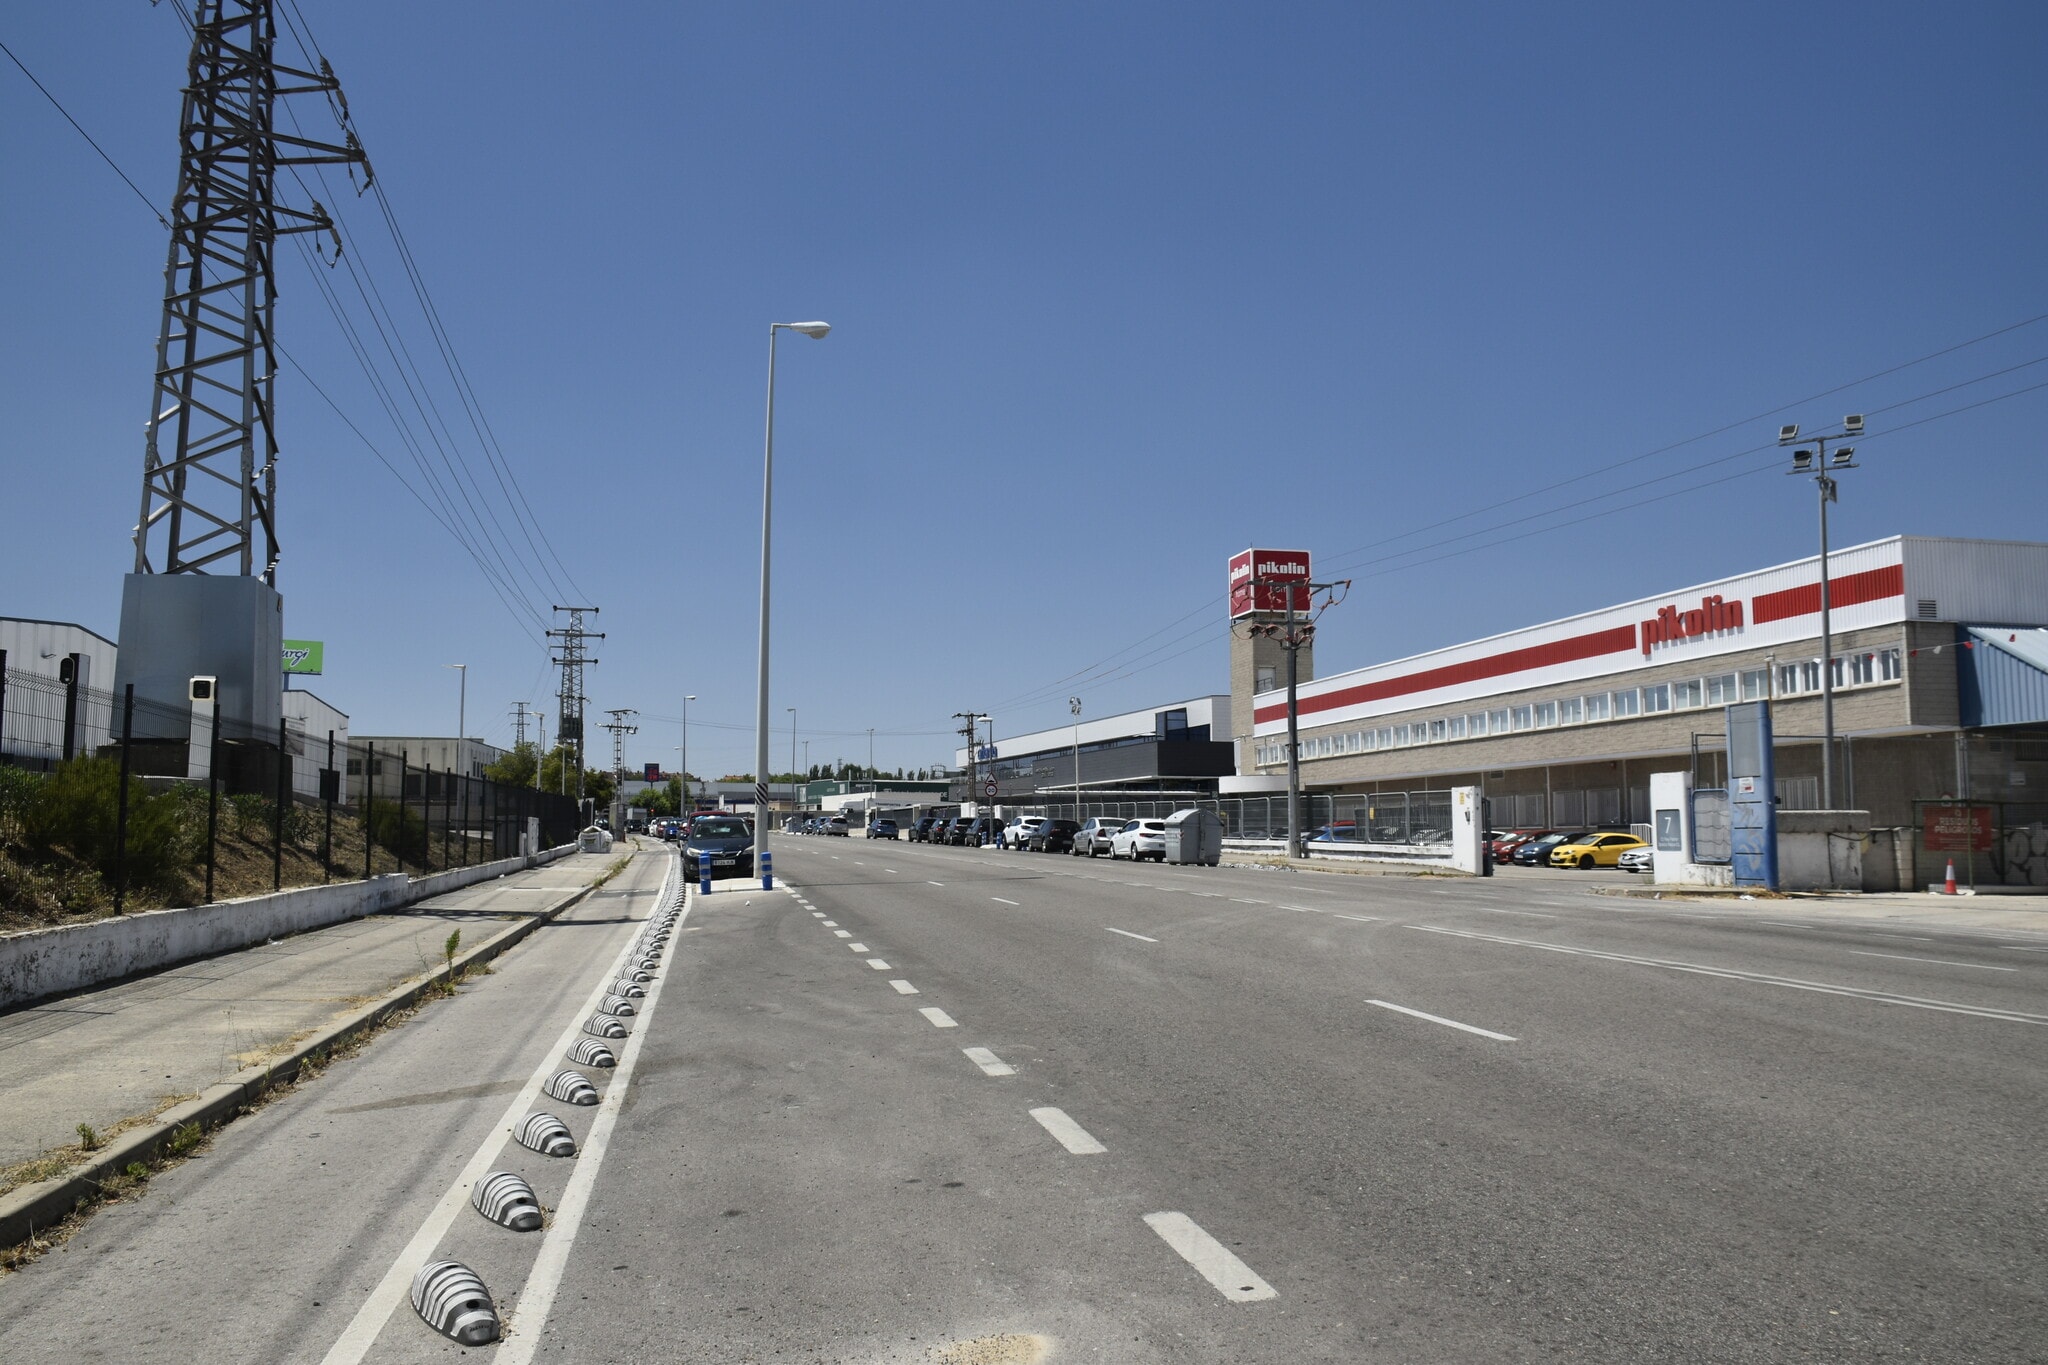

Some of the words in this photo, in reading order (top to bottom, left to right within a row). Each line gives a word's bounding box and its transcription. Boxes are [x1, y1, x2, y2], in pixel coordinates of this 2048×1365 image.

[1258, 561, 1306, 576] pikolin
[1641, 595, 1744, 655] pikolin
[282, 647, 309, 667] urgi
[1664, 816, 1671, 834] 7
[1934, 825, 1982, 834] PELIGROOS
